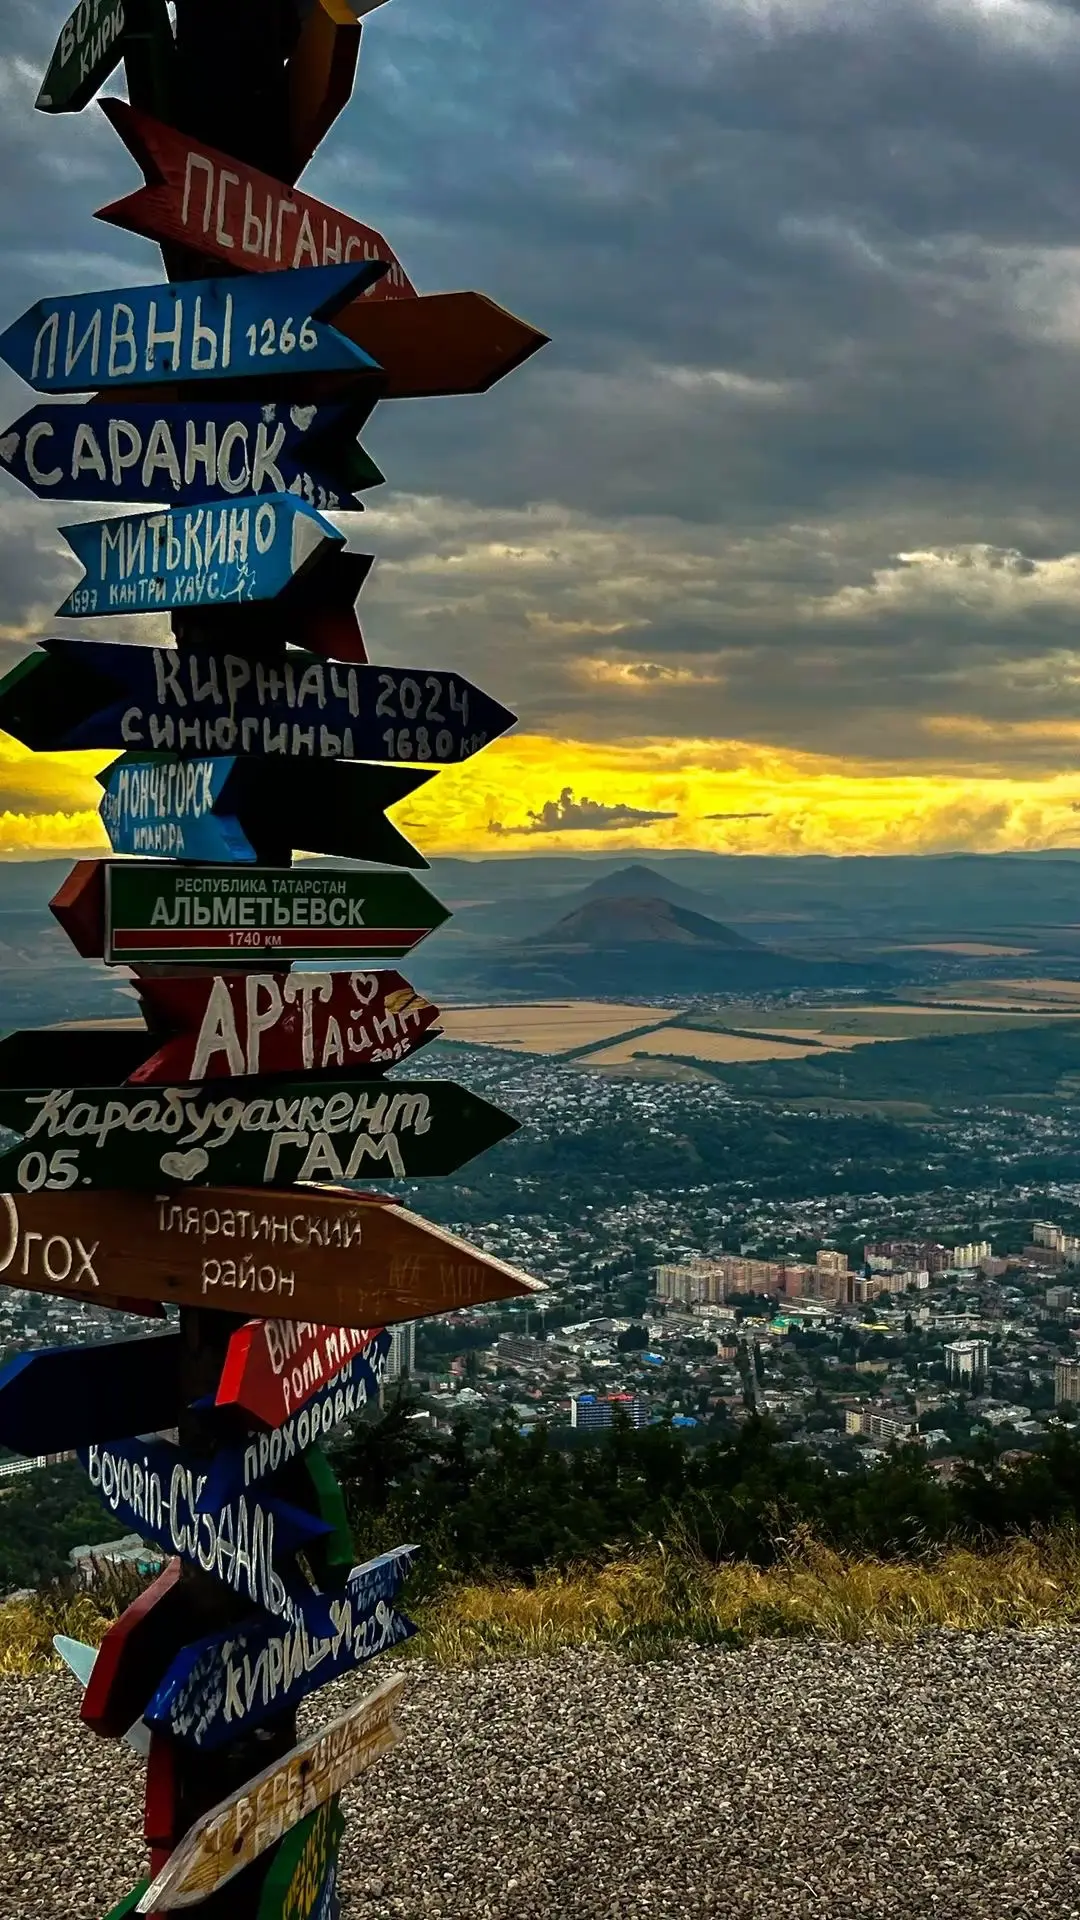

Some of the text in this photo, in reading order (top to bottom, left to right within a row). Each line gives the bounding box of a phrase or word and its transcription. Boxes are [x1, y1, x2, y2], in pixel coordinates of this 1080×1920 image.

[31, 294, 318, 380] ЛИВНЫ 1266
[100, 502, 276, 581] МИТЬКИНО
[70, 588, 98, 613] 1597
[109, 577, 167, 605] КАНТРИ
[375, 673, 470, 727] 2024
[121, 697, 355, 759] СИНЮГИНЫ
[382, 726, 453, 761] 1680
[118, 761, 214, 819] МОНЧЕГОРСК
[150, 896, 366, 926] АЛЬМЕТЬЕВСК
[175, 878, 347, 894] РЕСПУБЛИКА ТАТАРСТАН
[228, 932, 261, 946] 1740
[25, 1088, 433, 1149] Карабудахкент
[263, 1132, 406, 1182] ГАМ
[155, 1195, 362, 1248] Тляратинский
[202, 1253, 295, 1296] район
[244, 1378, 367, 1487] ПРОХОРОВКА
